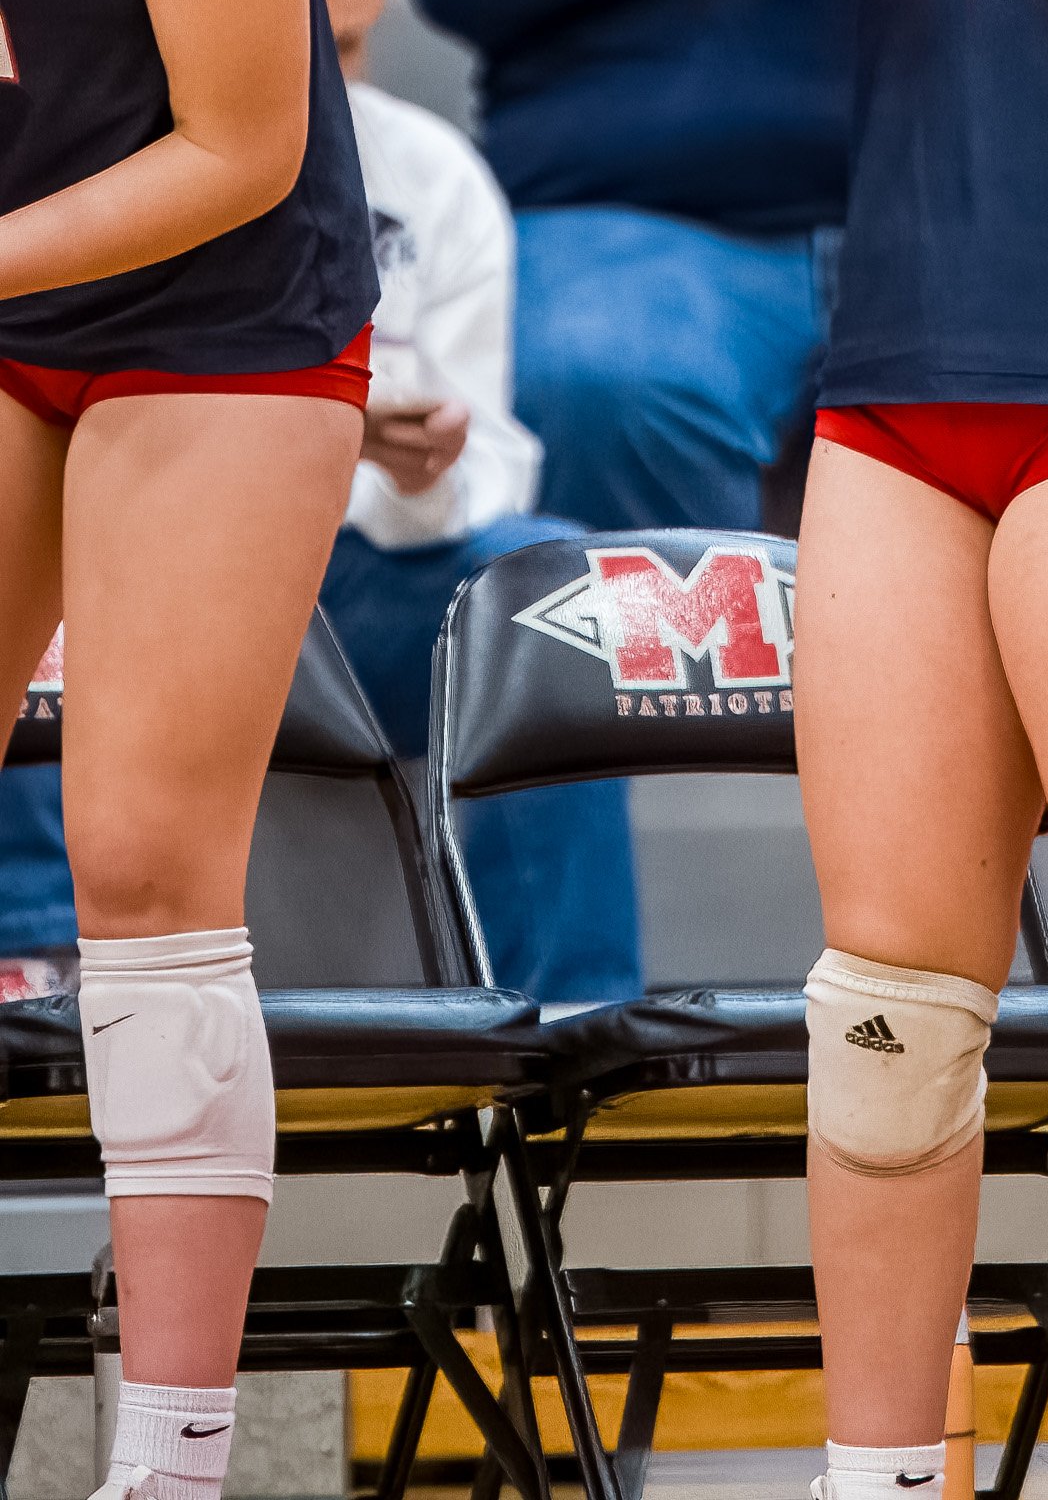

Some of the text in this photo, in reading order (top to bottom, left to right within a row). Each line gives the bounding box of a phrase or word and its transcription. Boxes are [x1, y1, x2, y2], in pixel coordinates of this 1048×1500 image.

[586, 547, 790, 690] M
[615, 691, 793, 718] PATRIOTS
[845, 1032, 905, 1054] adidas
